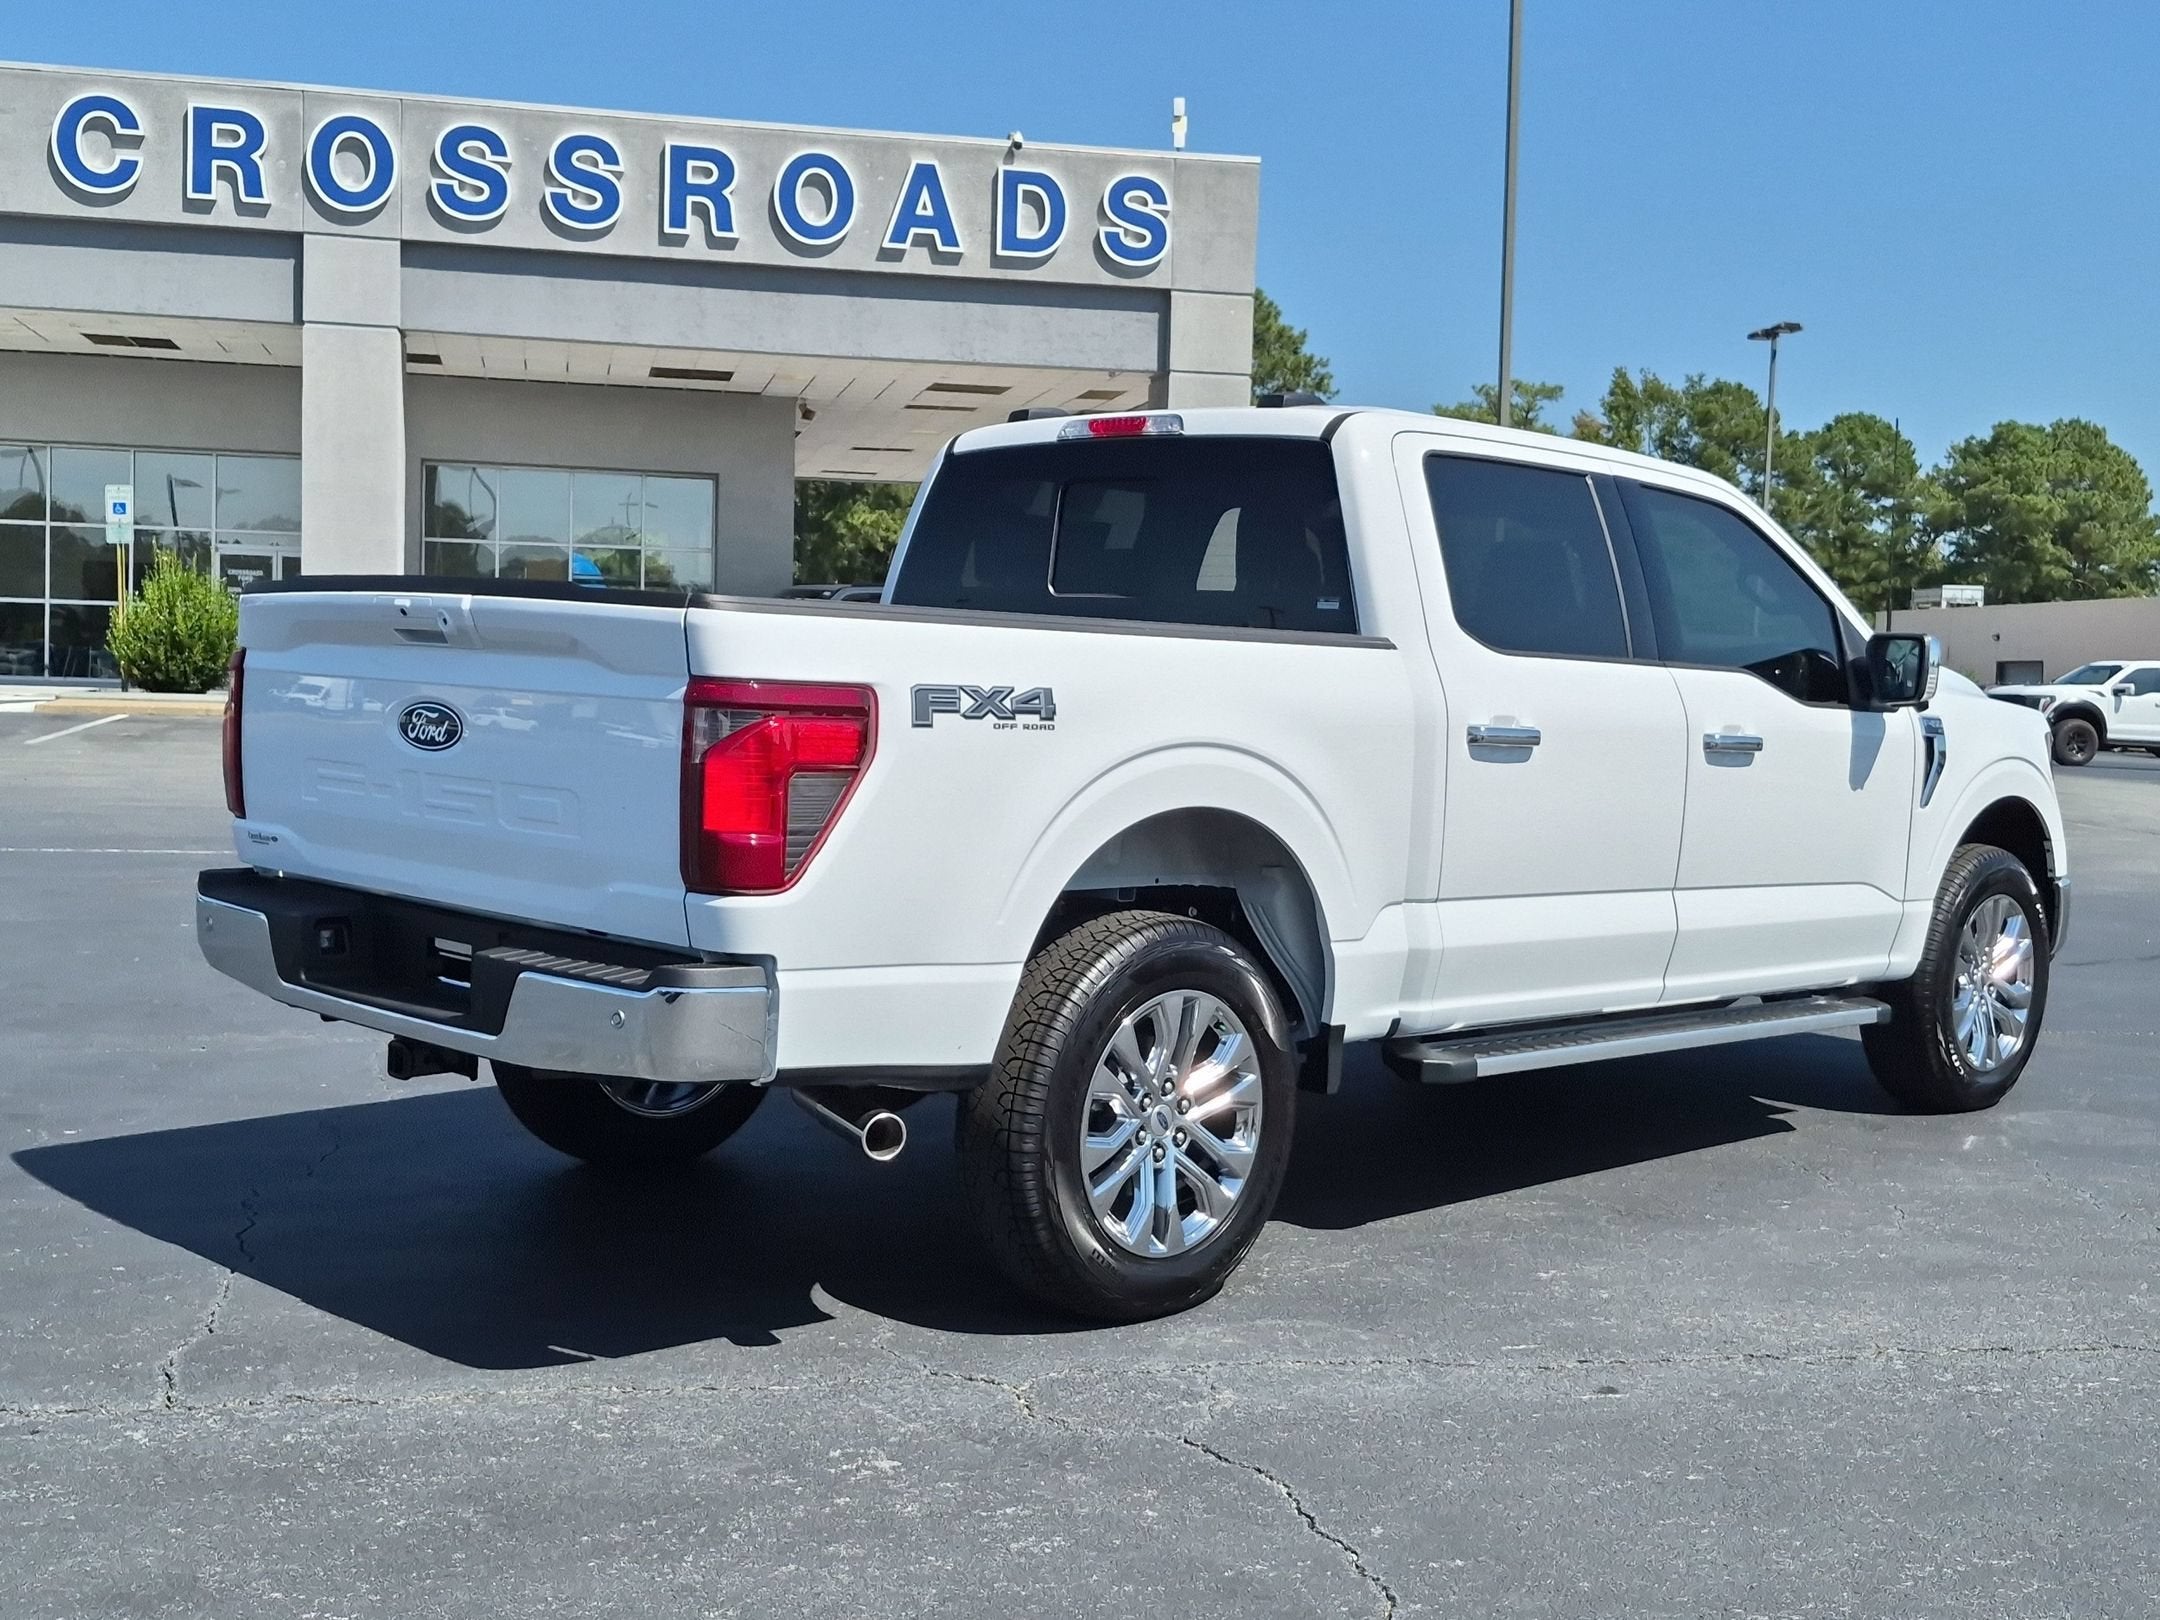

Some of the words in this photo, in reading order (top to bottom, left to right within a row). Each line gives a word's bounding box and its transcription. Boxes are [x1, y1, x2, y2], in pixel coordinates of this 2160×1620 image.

[51, 92, 1171, 267] CROSSROADS
[407, 708, 449, 743] Ford
[910, 684, 1057, 728] FX4
[993, 722, 1018, 730] OFF
[1022, 723, 1056, 731] ROAD
